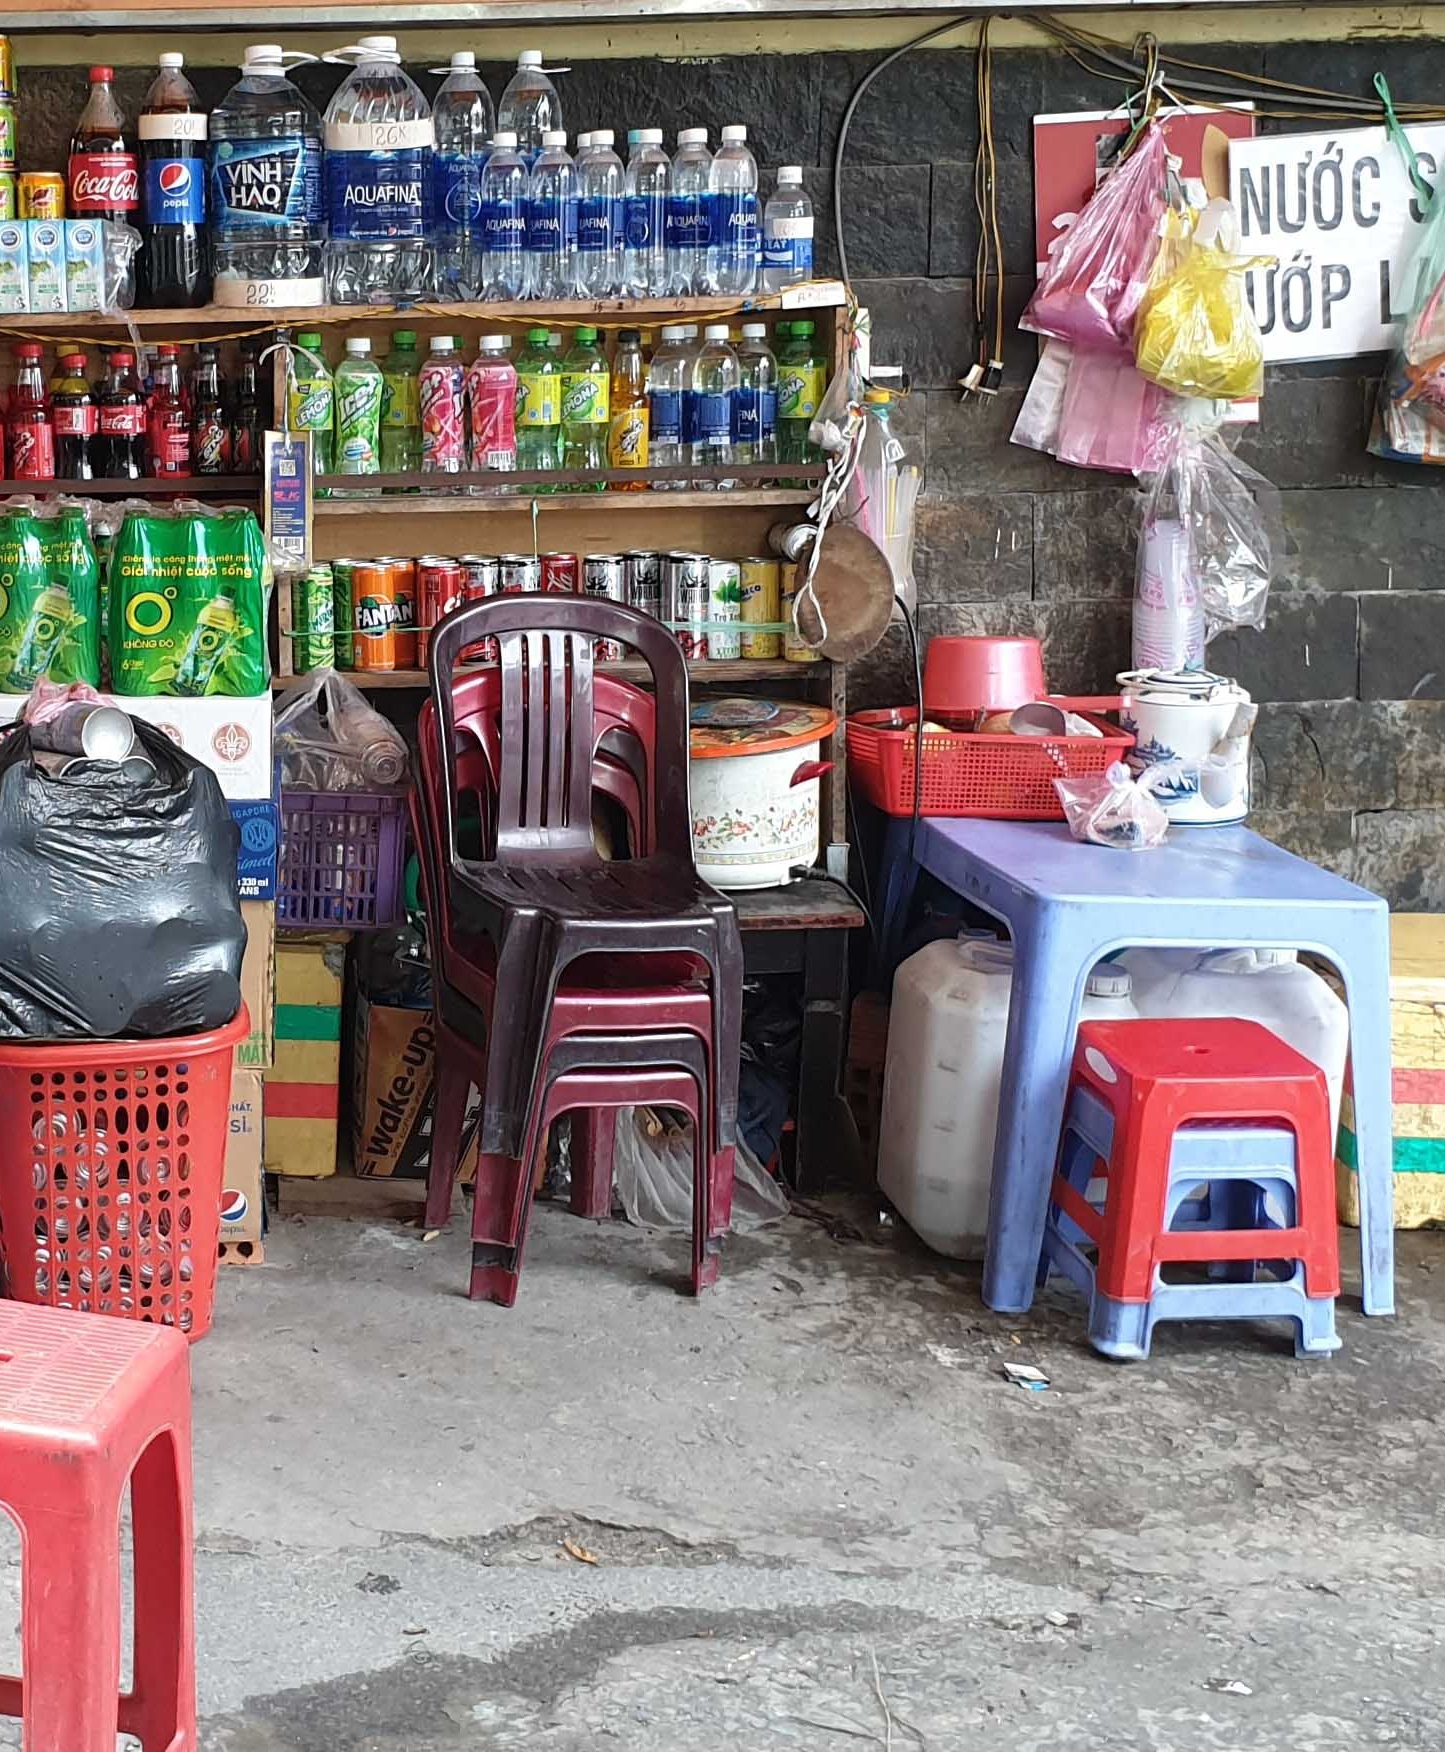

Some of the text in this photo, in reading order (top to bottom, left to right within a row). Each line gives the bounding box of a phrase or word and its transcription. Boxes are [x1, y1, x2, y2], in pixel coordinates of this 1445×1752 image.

[73, 169, 139, 202] Coca-Col
[344, 184, 419, 207] AQUAFINA
[1240, 141, 1381, 237] NƯỚC
[485, 217, 526, 232] AQUAFINA
[296, 389, 333, 427] LEMON
[221, 562, 253, 579] sống
[354, 603, 394, 629] FANT
[233, 804, 270, 819] GAPORE
[239, 886, 259, 896] ANS
[242, 877, 256, 887] 330
